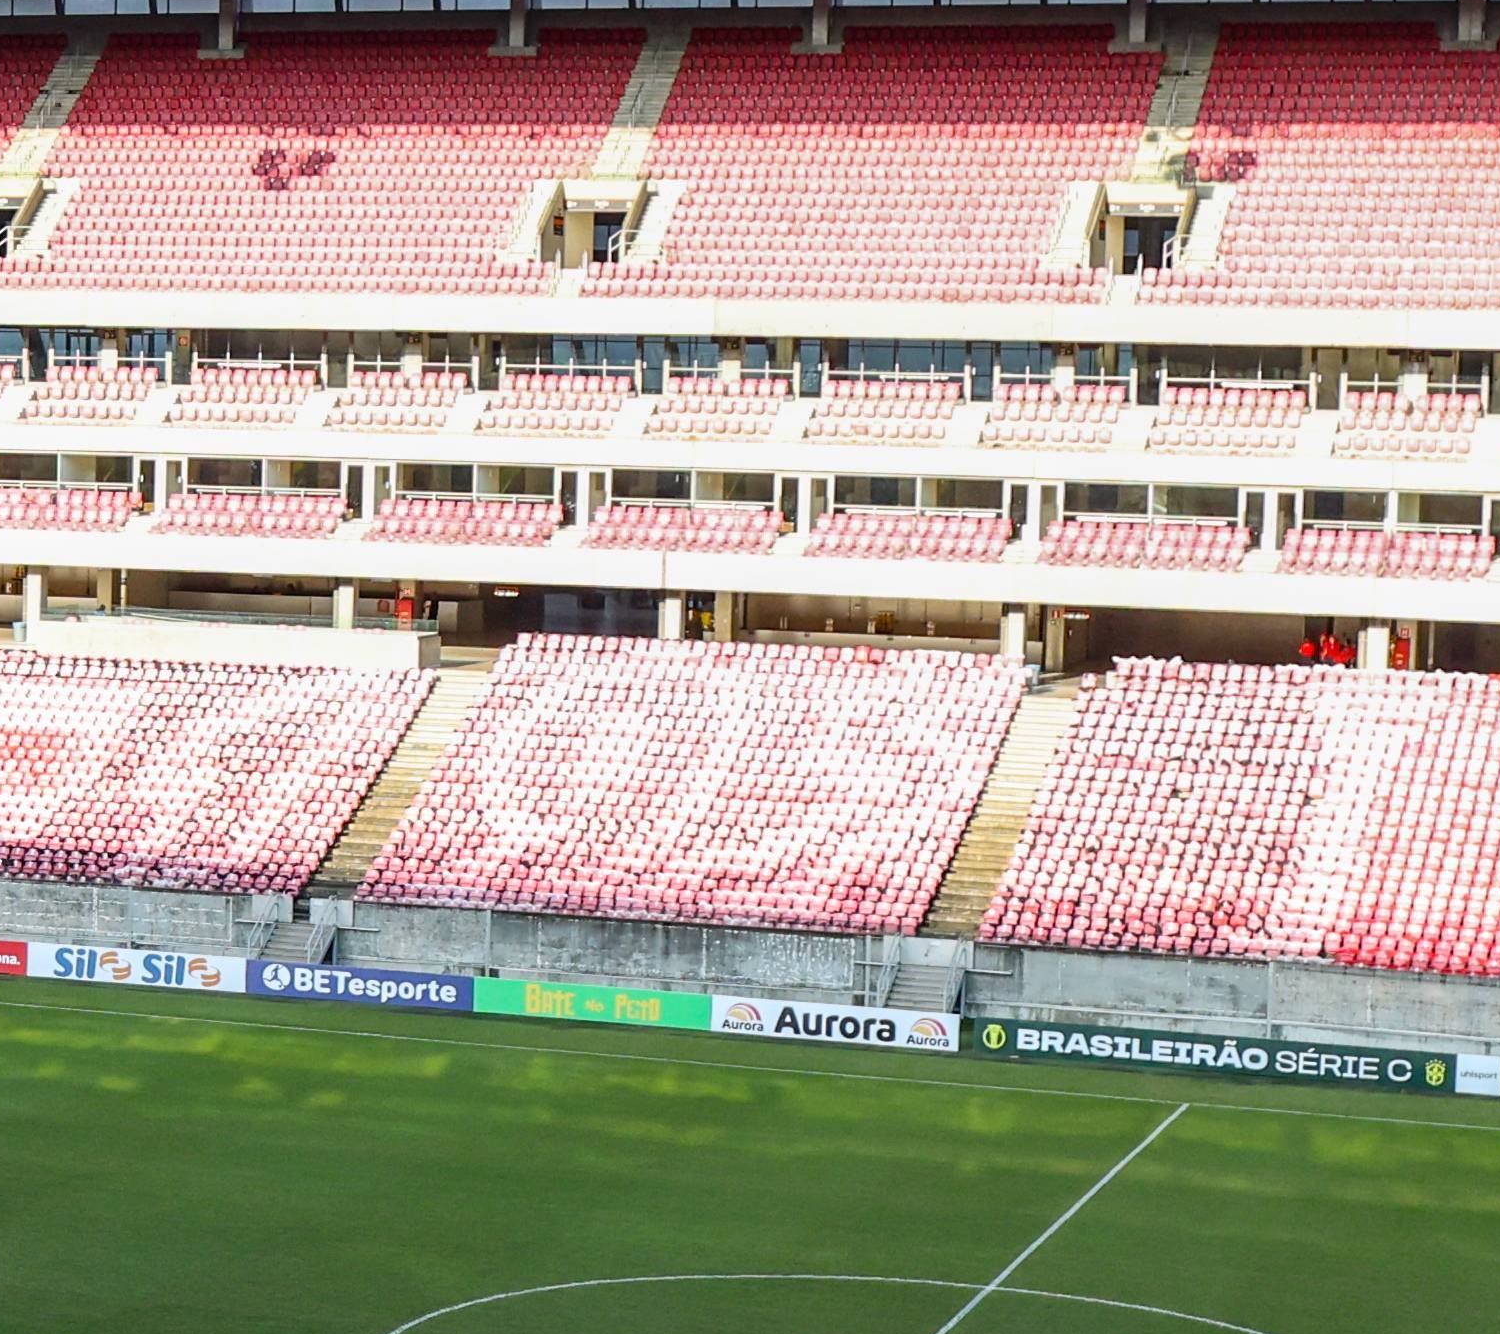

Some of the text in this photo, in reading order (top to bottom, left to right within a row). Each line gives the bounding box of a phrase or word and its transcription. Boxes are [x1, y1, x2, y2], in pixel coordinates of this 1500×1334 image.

[53, 947, 185, 986] Sil Sil
[293, 966, 457, 1004] BETesporte
[721, 1005, 950, 1048] Aurora Aurora Aurora
[1016, 1027, 1412, 1083] BRASILEIRÃO SÉRIE C
